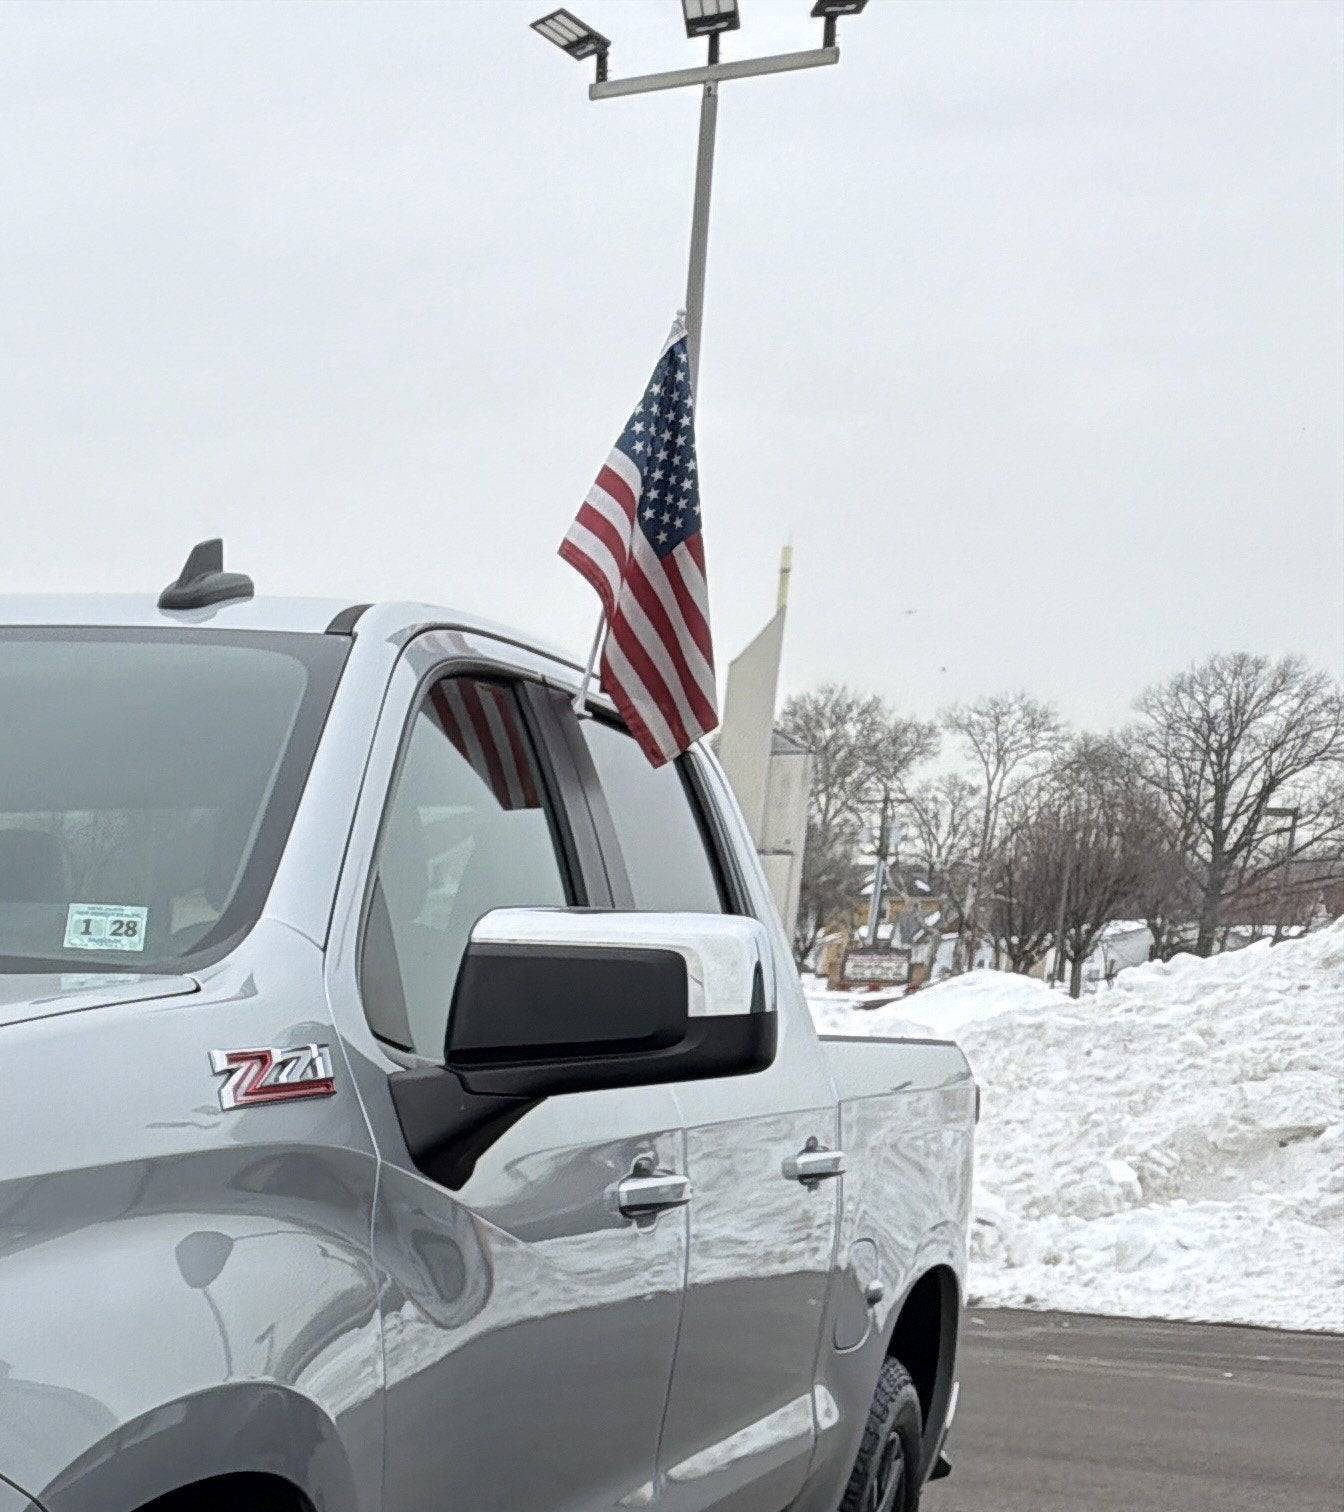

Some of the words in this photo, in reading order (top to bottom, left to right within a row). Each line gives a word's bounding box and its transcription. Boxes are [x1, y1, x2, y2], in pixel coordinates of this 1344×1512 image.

[80, 918, 93, 936] 1
[109, 919, 138, 938] 28
[208, 1044, 336, 1112] Z71
